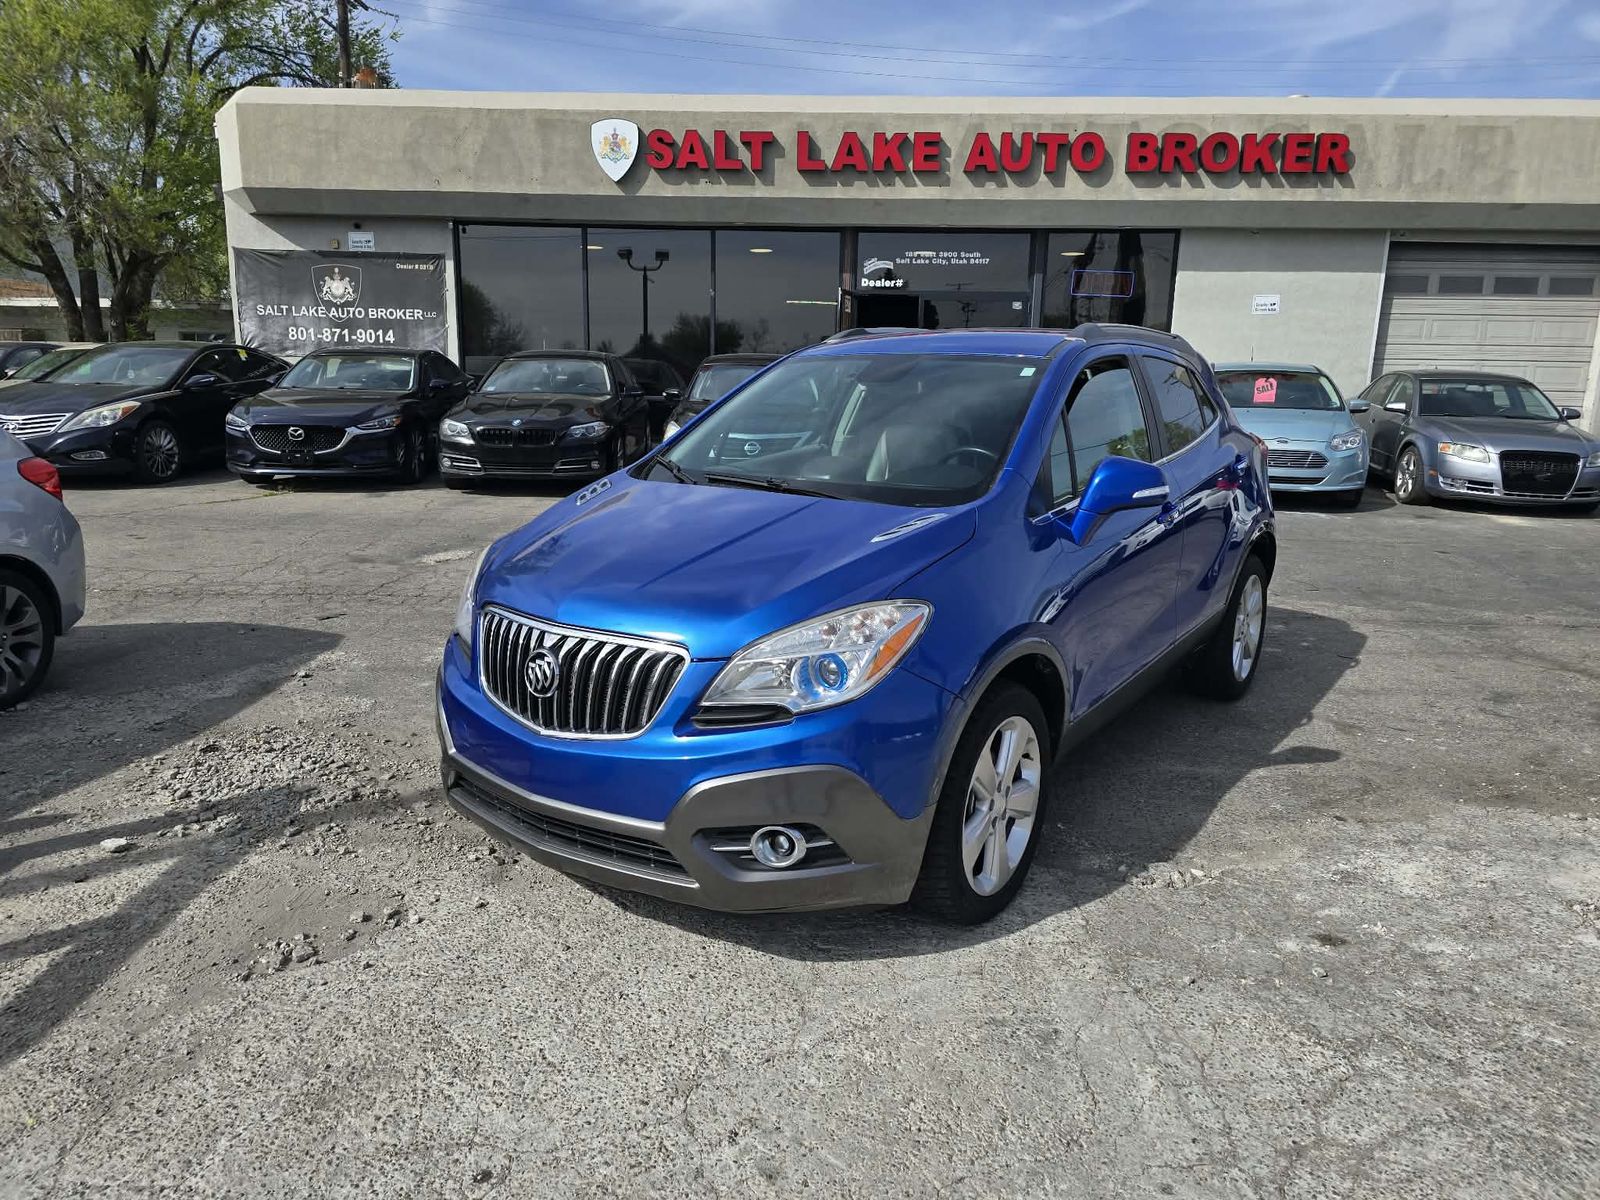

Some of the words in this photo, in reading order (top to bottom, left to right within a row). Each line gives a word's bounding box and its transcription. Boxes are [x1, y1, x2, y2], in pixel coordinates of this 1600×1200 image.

[646, 129, 774, 171] SALT
[797, 131, 942, 172] LAKE
[963, 131, 1106, 174] AUTO
[1125, 131, 1351, 175] BROKER
[256, 304, 289, 316] SALT
[292, 305, 326, 317] LAKE
[329, 307, 365, 319] AUTO
[368, 308, 424, 320] BROKER
[288, 326, 396, 344] 801-871-9014
[1255, 382, 1275, 395] SALE
